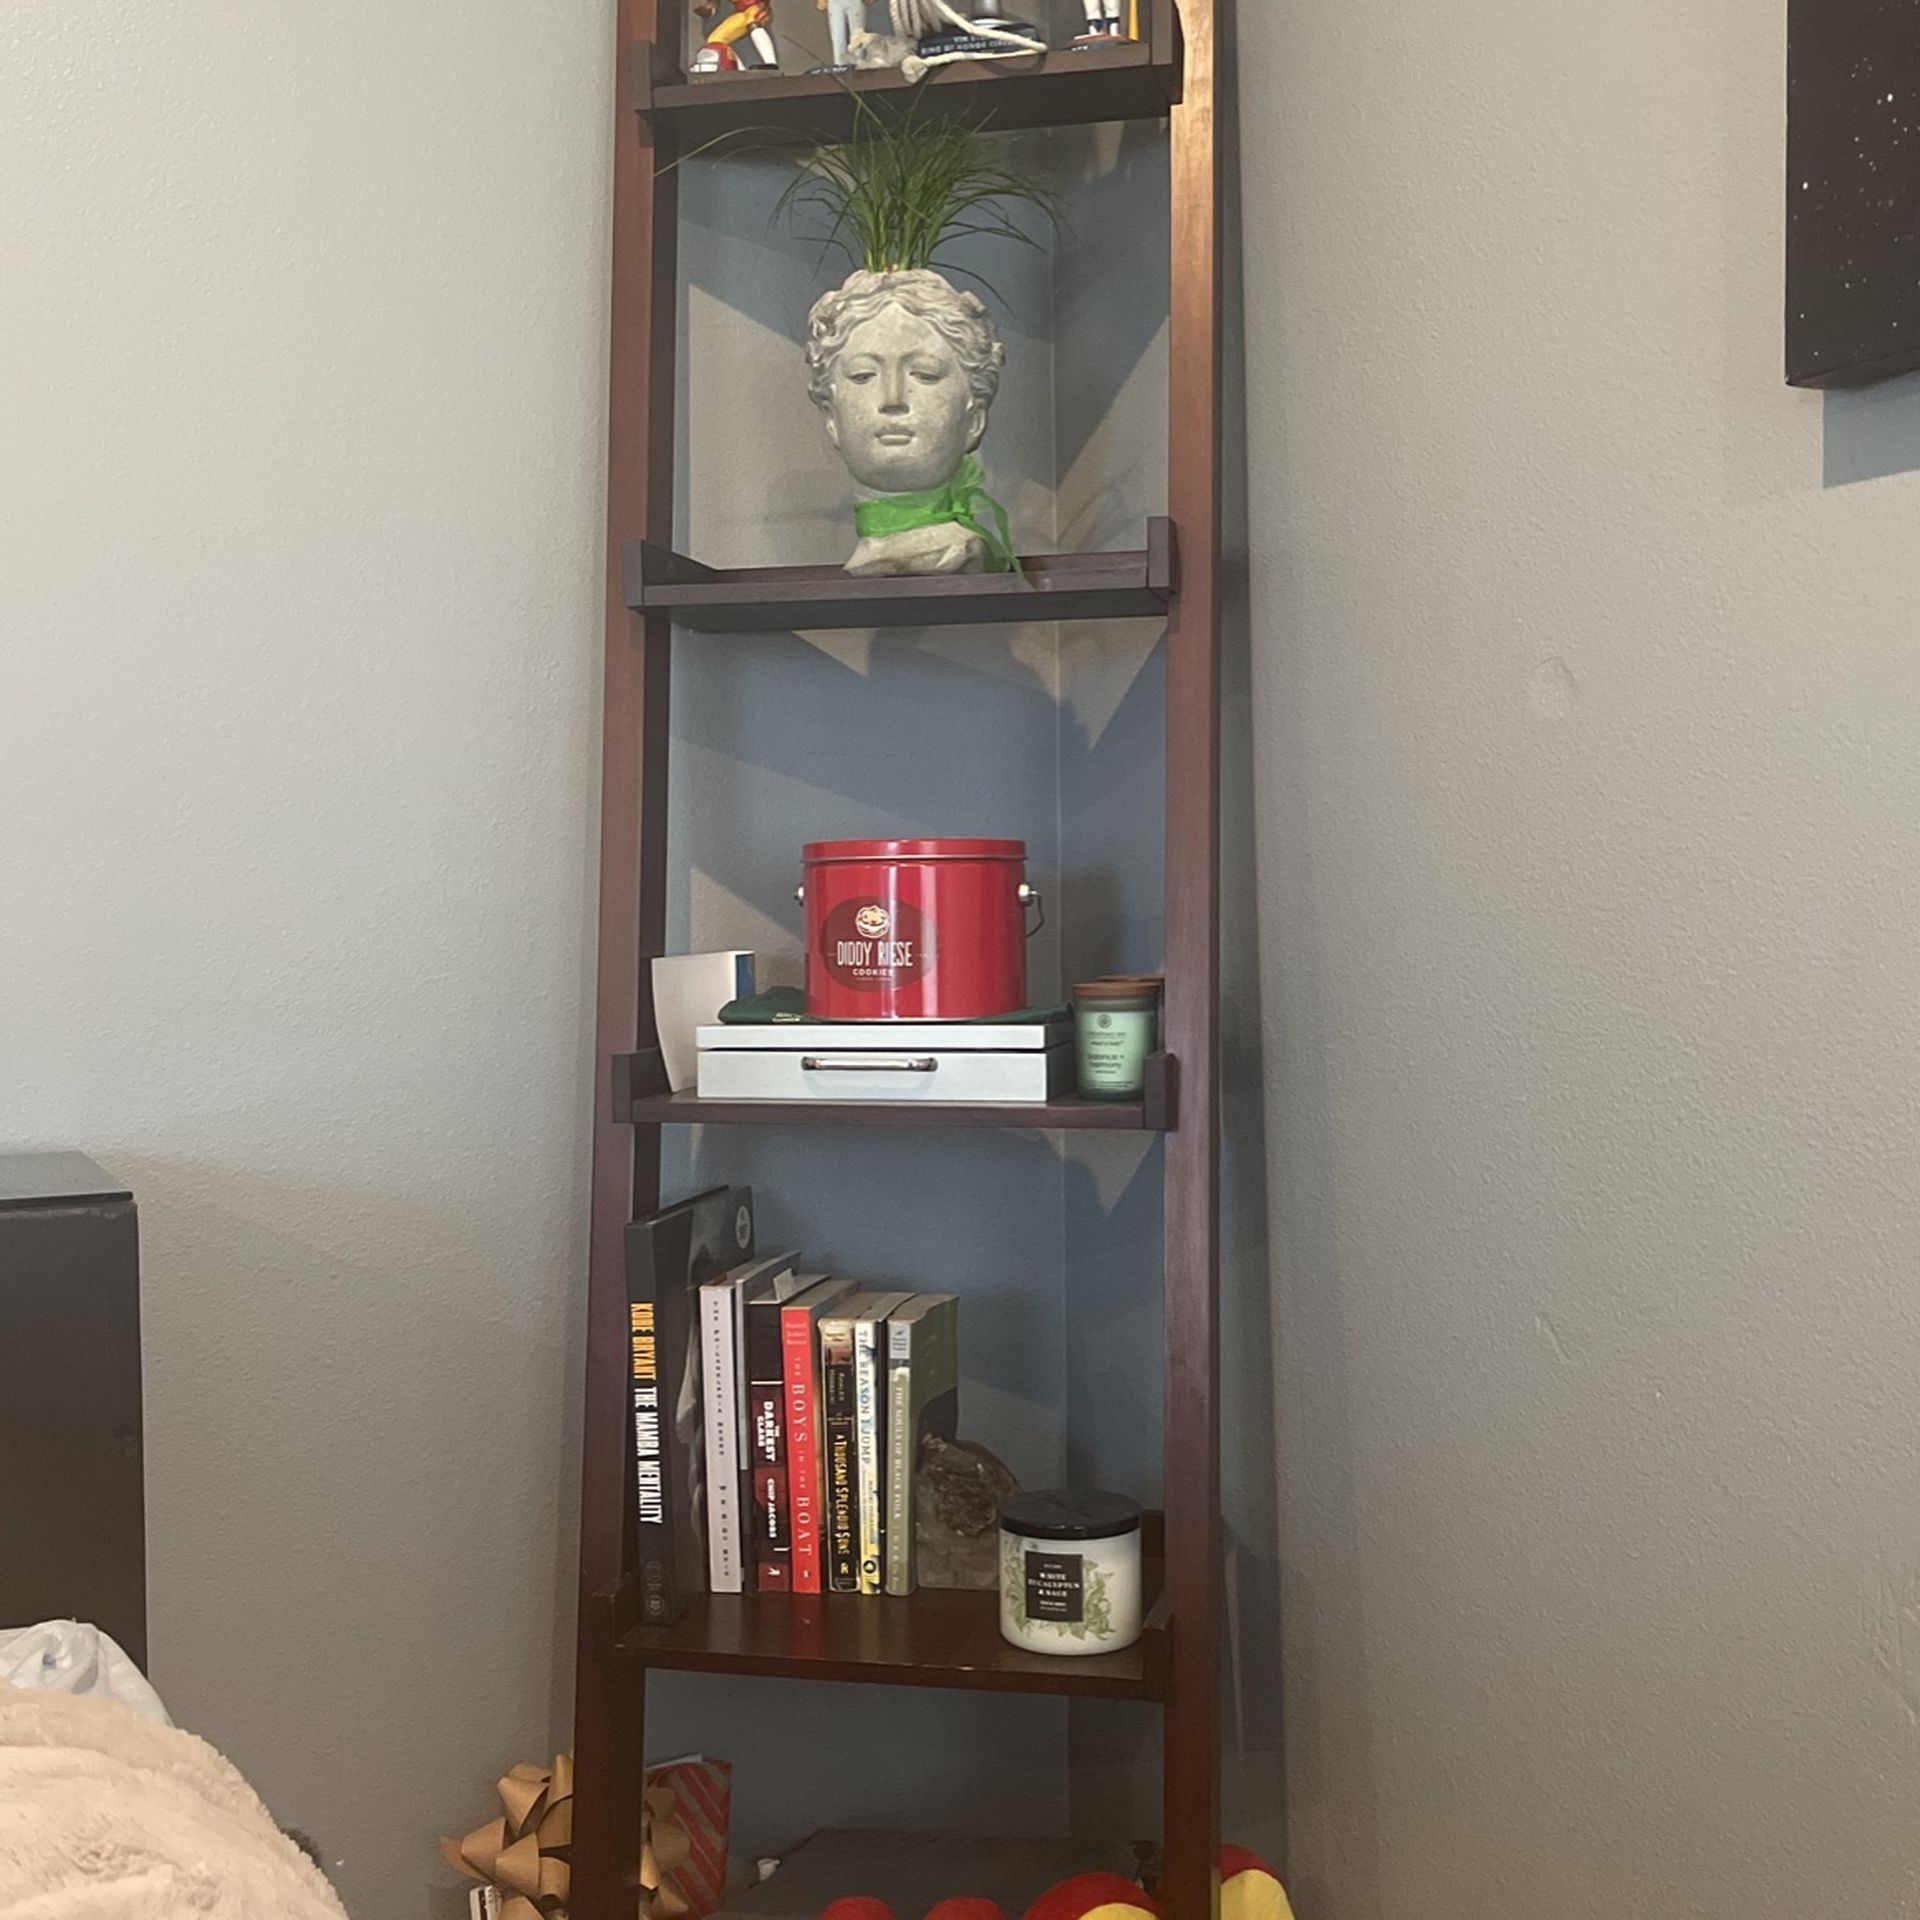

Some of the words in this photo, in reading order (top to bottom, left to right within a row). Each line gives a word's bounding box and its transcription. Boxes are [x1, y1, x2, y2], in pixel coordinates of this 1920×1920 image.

[837, 941, 872, 966] DIDDY
[877, 941, 913, 967] RIESE
[852, 968, 895, 976] COOKIES
[630, 1303, 654, 1332] KOBE
[632, 1336, 657, 1380] BRYANT
[858, 1329, 869, 1357] THE
[794, 1357, 802, 1377] THE
[634, 1386, 658, 1408] THE
[859, 1362, 870, 1415] REASON
[895, 1386, 903, 1405] THE
[792, 1384, 808, 1443] BOYS
[895, 1408, 903, 1440] SOULS
[636, 1412, 660, 1457] MAMBA
[757, 1415, 766, 1448] GLARE
[763, 1401, 776, 1462] DARKEST
[861, 1429, 872, 1464] JUMP
[798, 1447, 805, 1463] IN
[833, 1441, 849, 1486] THOUSAND
[895, 1442, 902, 1456] OF
[767, 1478, 775, 1501] CHIP
[799, 1469, 807, 1489] THE
[894, 1459, 902, 1490] BLACK
[638, 1461, 663, 1523] MENTALITY
[893, 1494, 901, 1520] FOLK
[768, 1502, 778, 1539] JACOBS
[834, 1486, 850, 1531] SPLENDID
[797, 1497, 813, 1557] BOAT
[834, 1531, 852, 1556] SUNS
